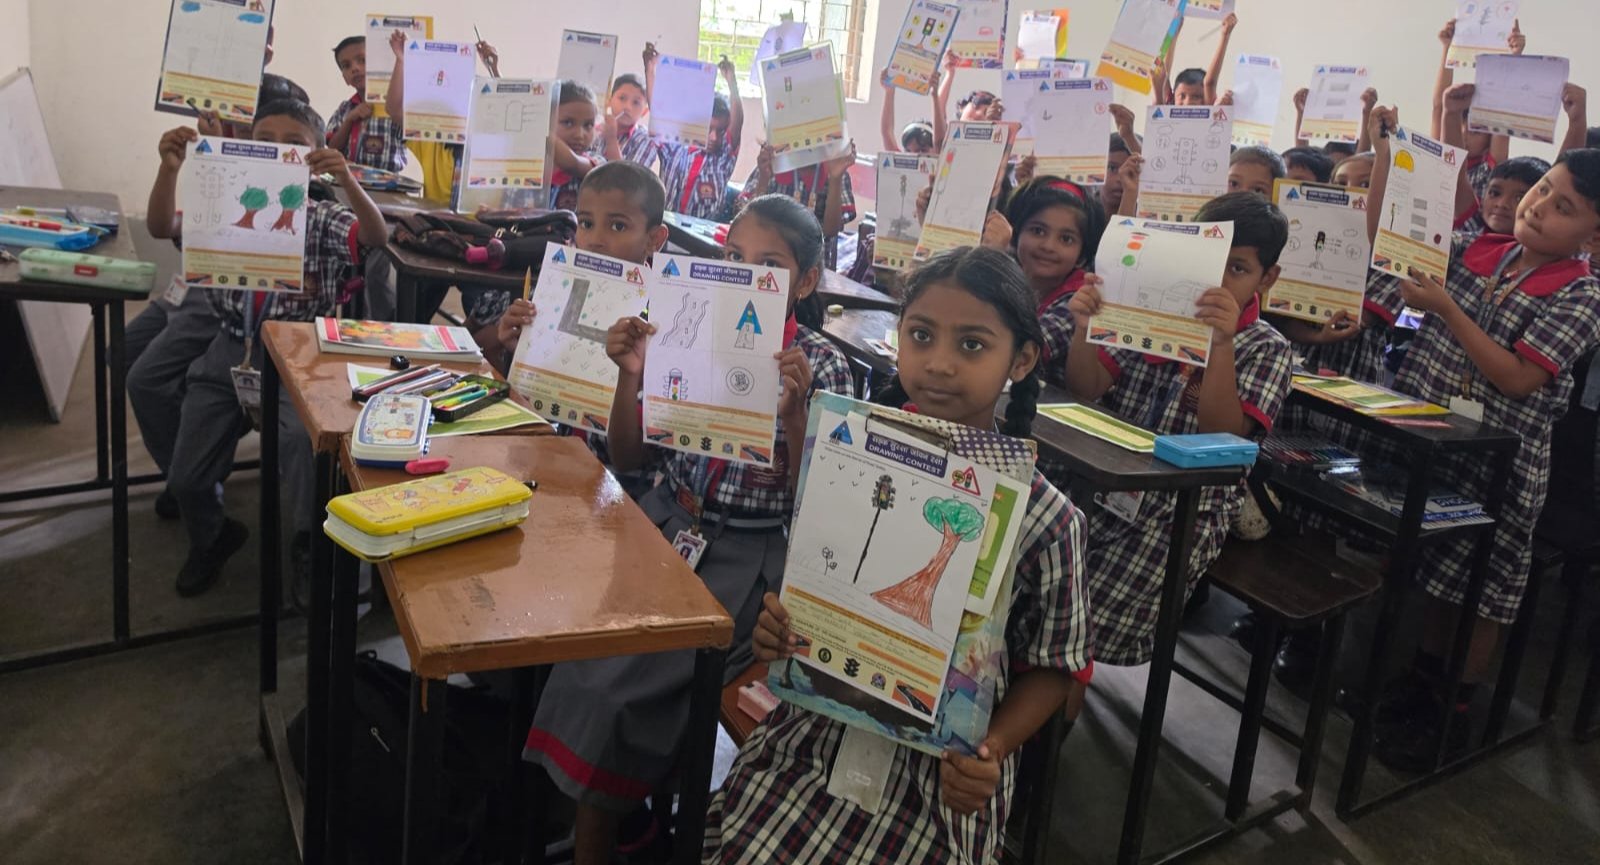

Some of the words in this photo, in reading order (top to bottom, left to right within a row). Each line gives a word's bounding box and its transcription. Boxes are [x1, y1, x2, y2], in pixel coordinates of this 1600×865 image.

[693, 272, 720, 280] DRAWING
[868, 444, 904, 461] DRAWING
[905, 457, 941, 474] CONTEST
